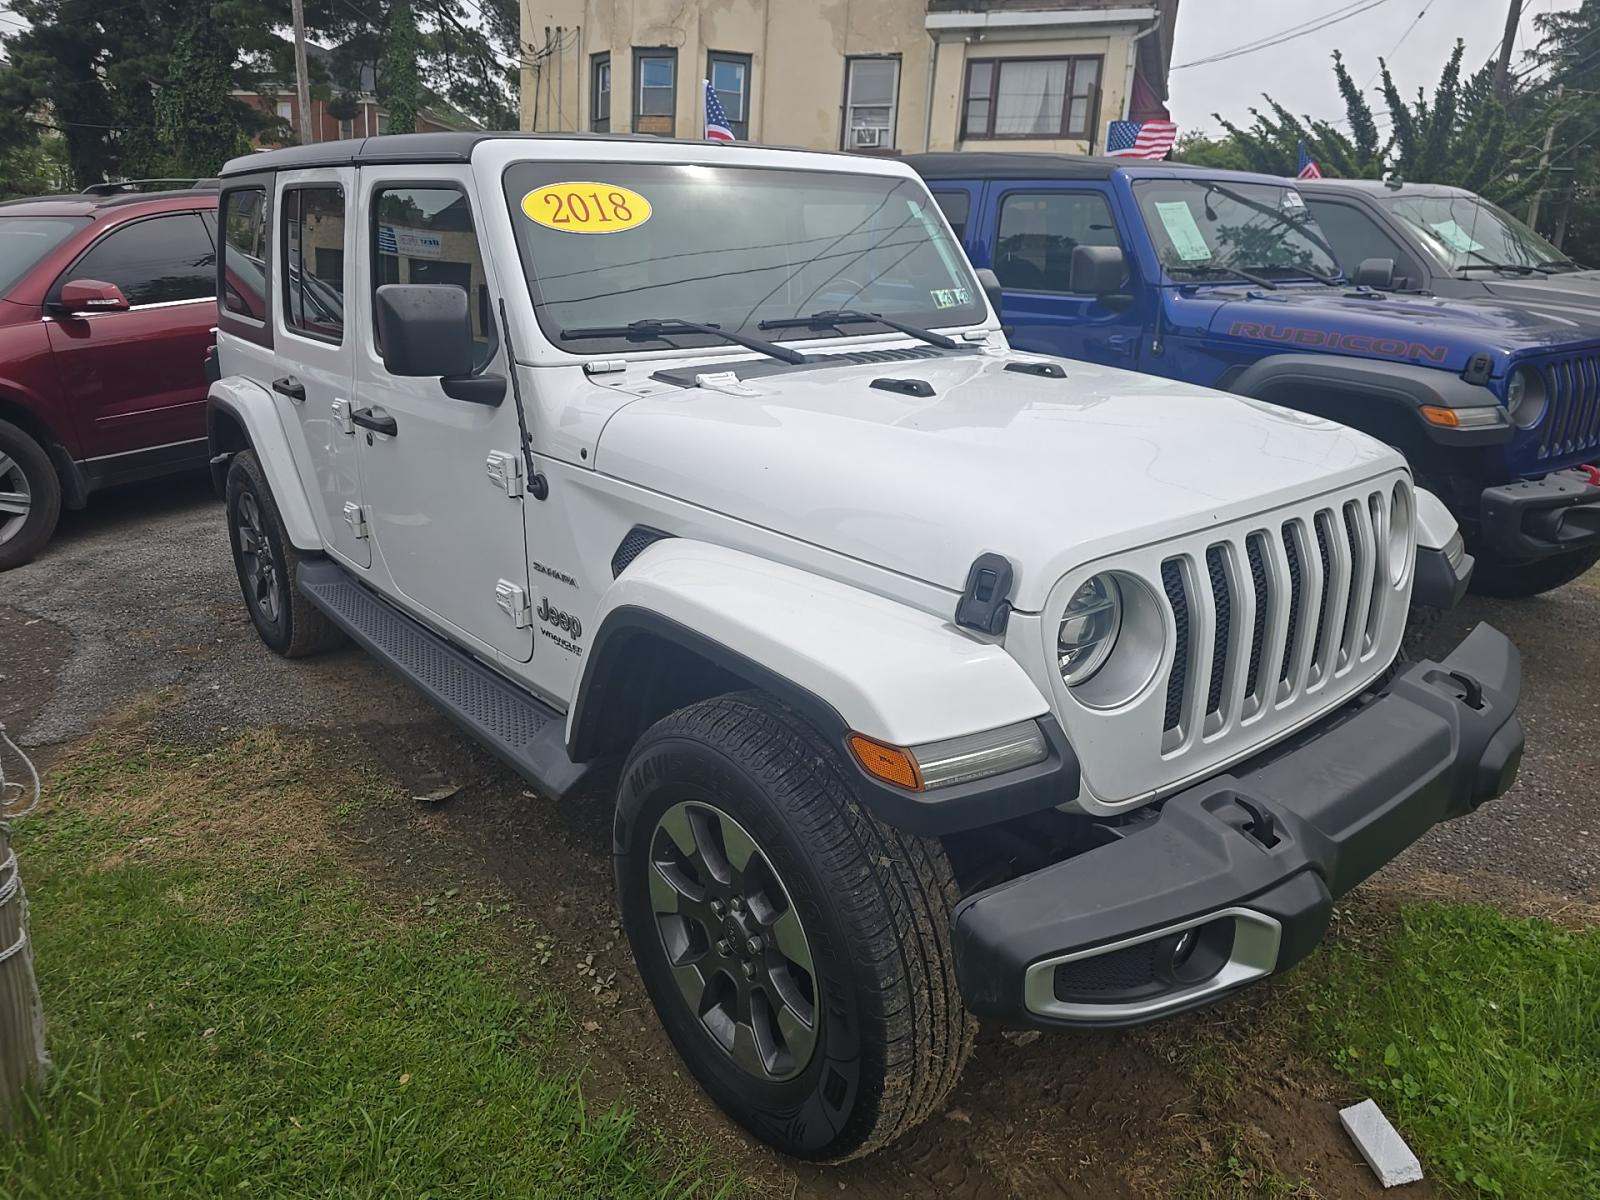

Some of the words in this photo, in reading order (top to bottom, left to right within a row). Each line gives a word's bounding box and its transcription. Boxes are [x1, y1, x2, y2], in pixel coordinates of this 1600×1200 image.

[543, 192, 632, 223] 2018
[1228, 320, 1449, 363] RUBICON
[533, 561, 579, 589] SAHARA
[537, 597, 582, 640] Jeep
